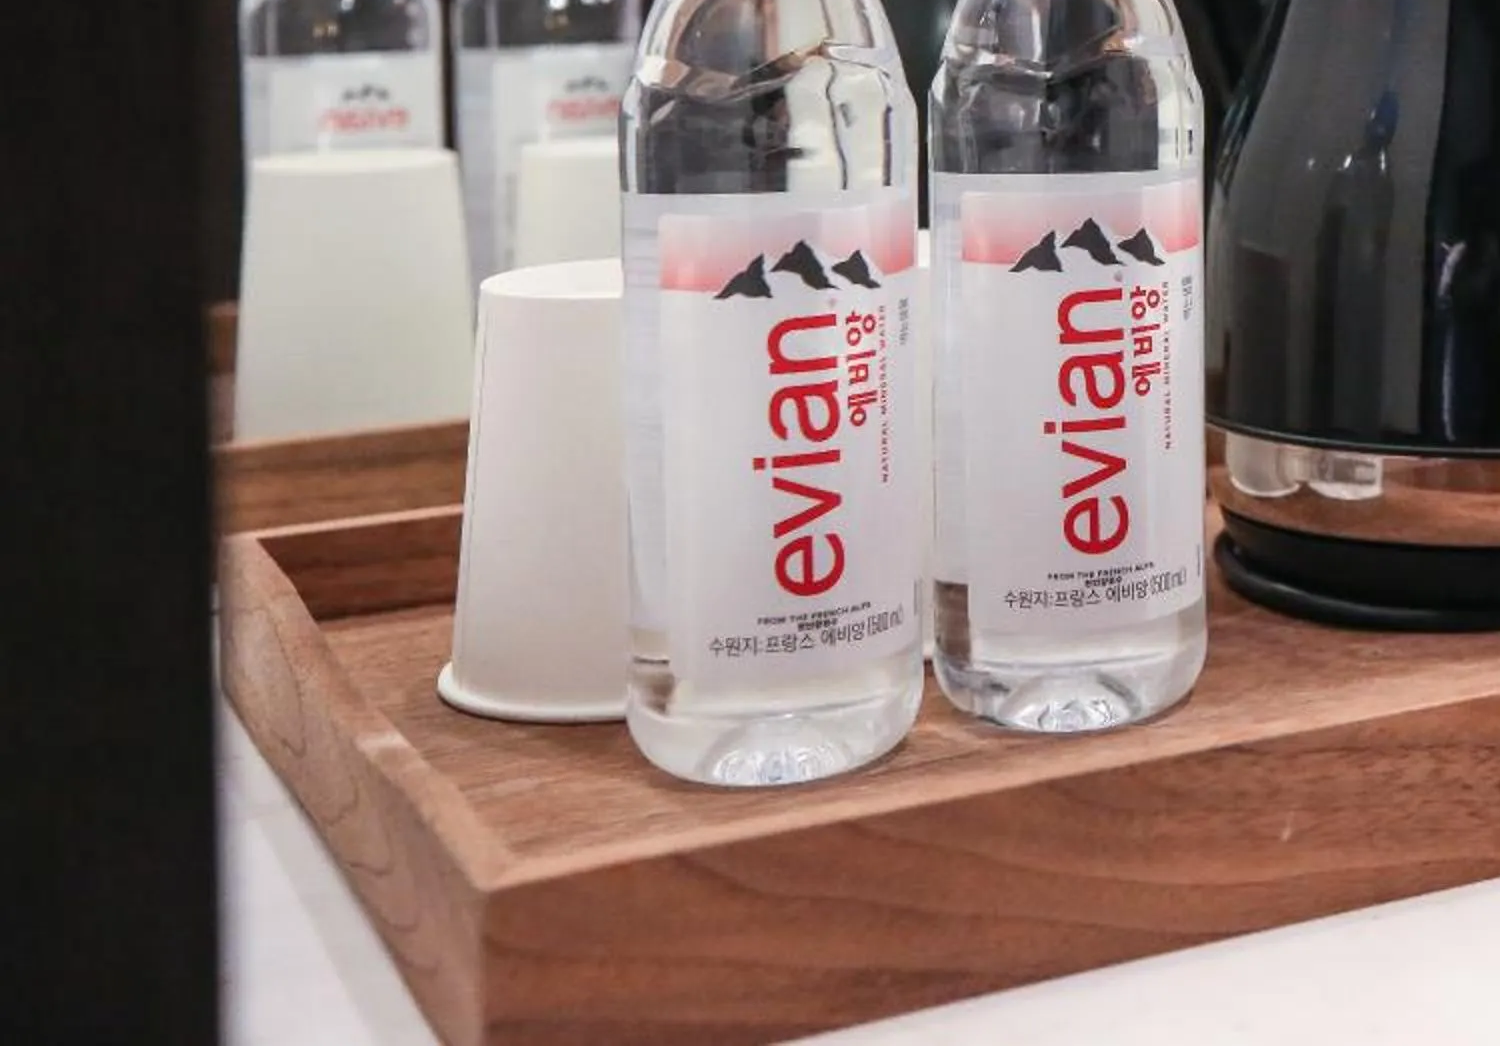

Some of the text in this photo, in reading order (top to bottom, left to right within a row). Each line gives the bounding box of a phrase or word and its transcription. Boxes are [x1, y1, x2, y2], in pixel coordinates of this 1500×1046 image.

[845, 310, 878, 427] 에비앙
[1130, 285, 1161, 396] 에비앙
[753, 313, 846, 596] evian
[1044, 287, 1130, 555] evian
[820, 621, 866, 645] 에비앙
[1105, 580, 1149, 603] 에비앙
